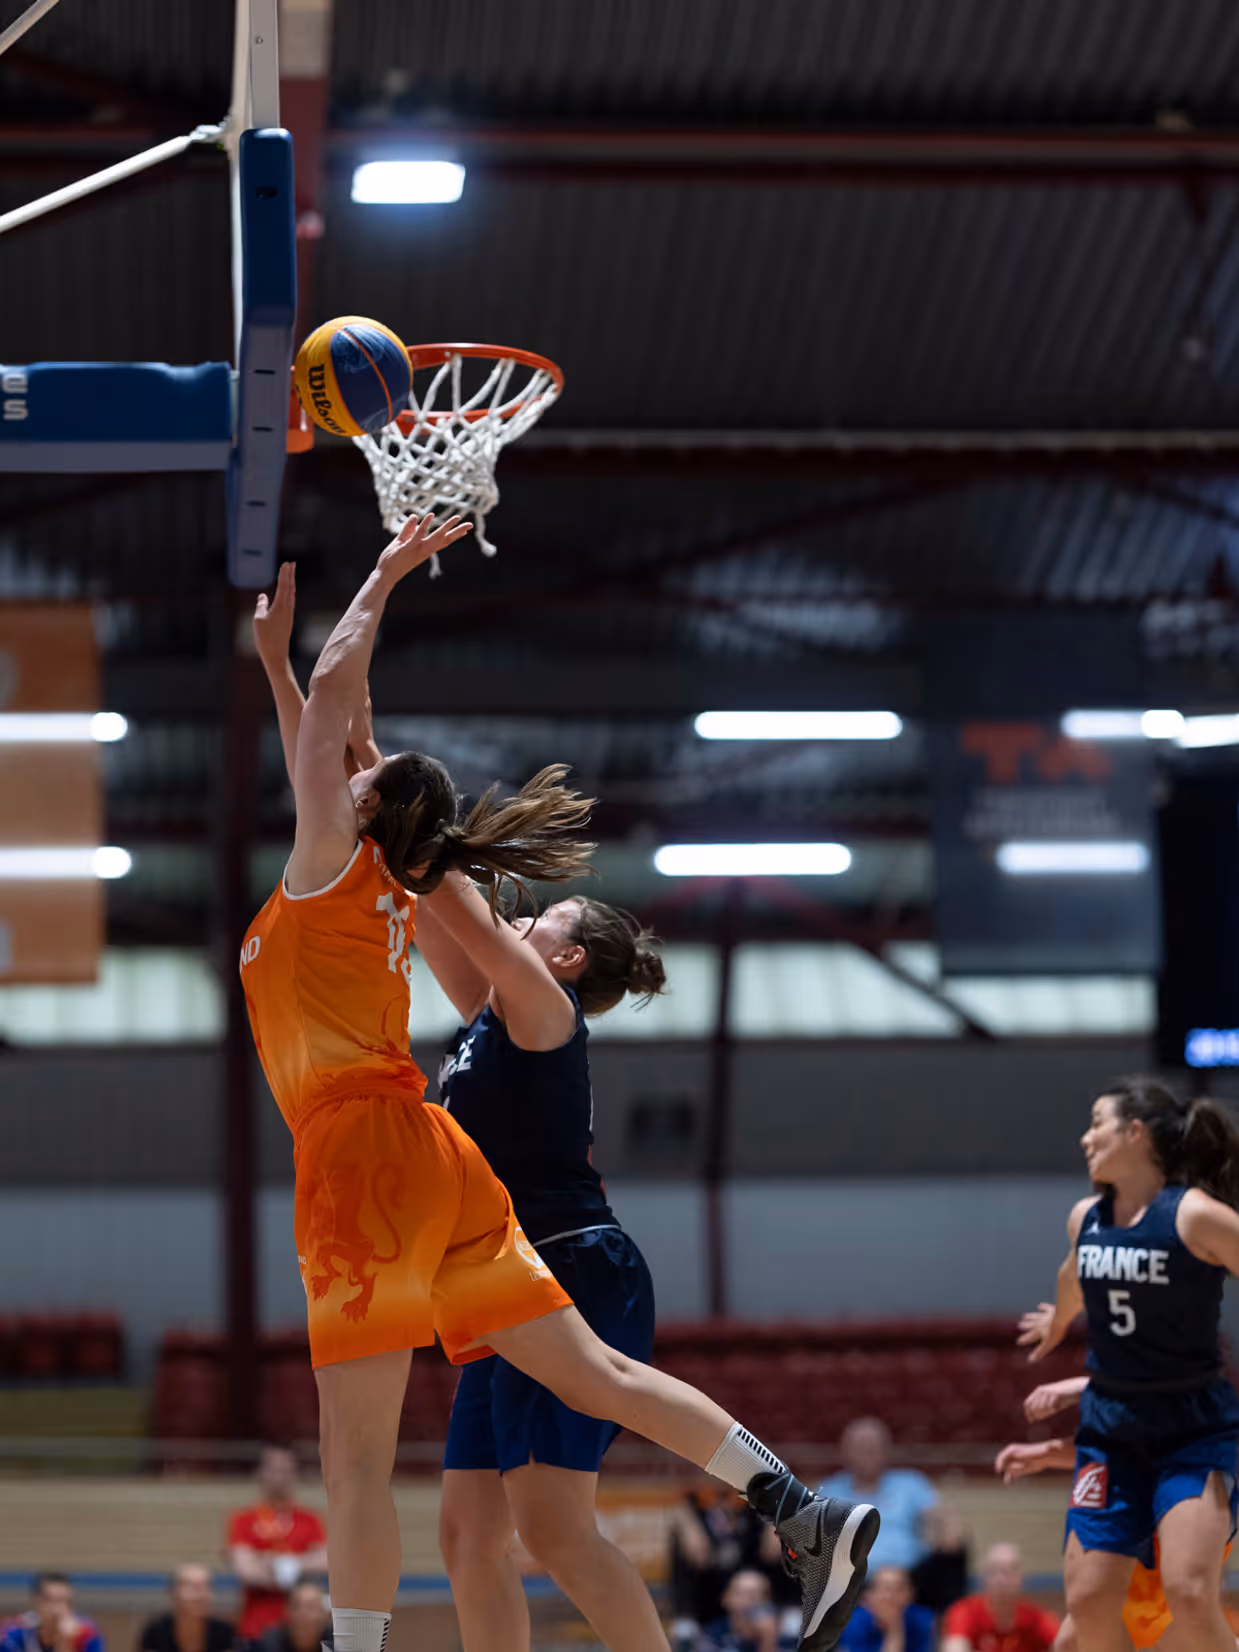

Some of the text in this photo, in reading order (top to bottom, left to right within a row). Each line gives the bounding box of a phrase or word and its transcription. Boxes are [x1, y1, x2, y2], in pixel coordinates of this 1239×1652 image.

[308, 363, 347, 434] Wilson
[1077, 1244, 1170, 1285] FRANCE
[1107, 1289, 1136, 1336] 5
